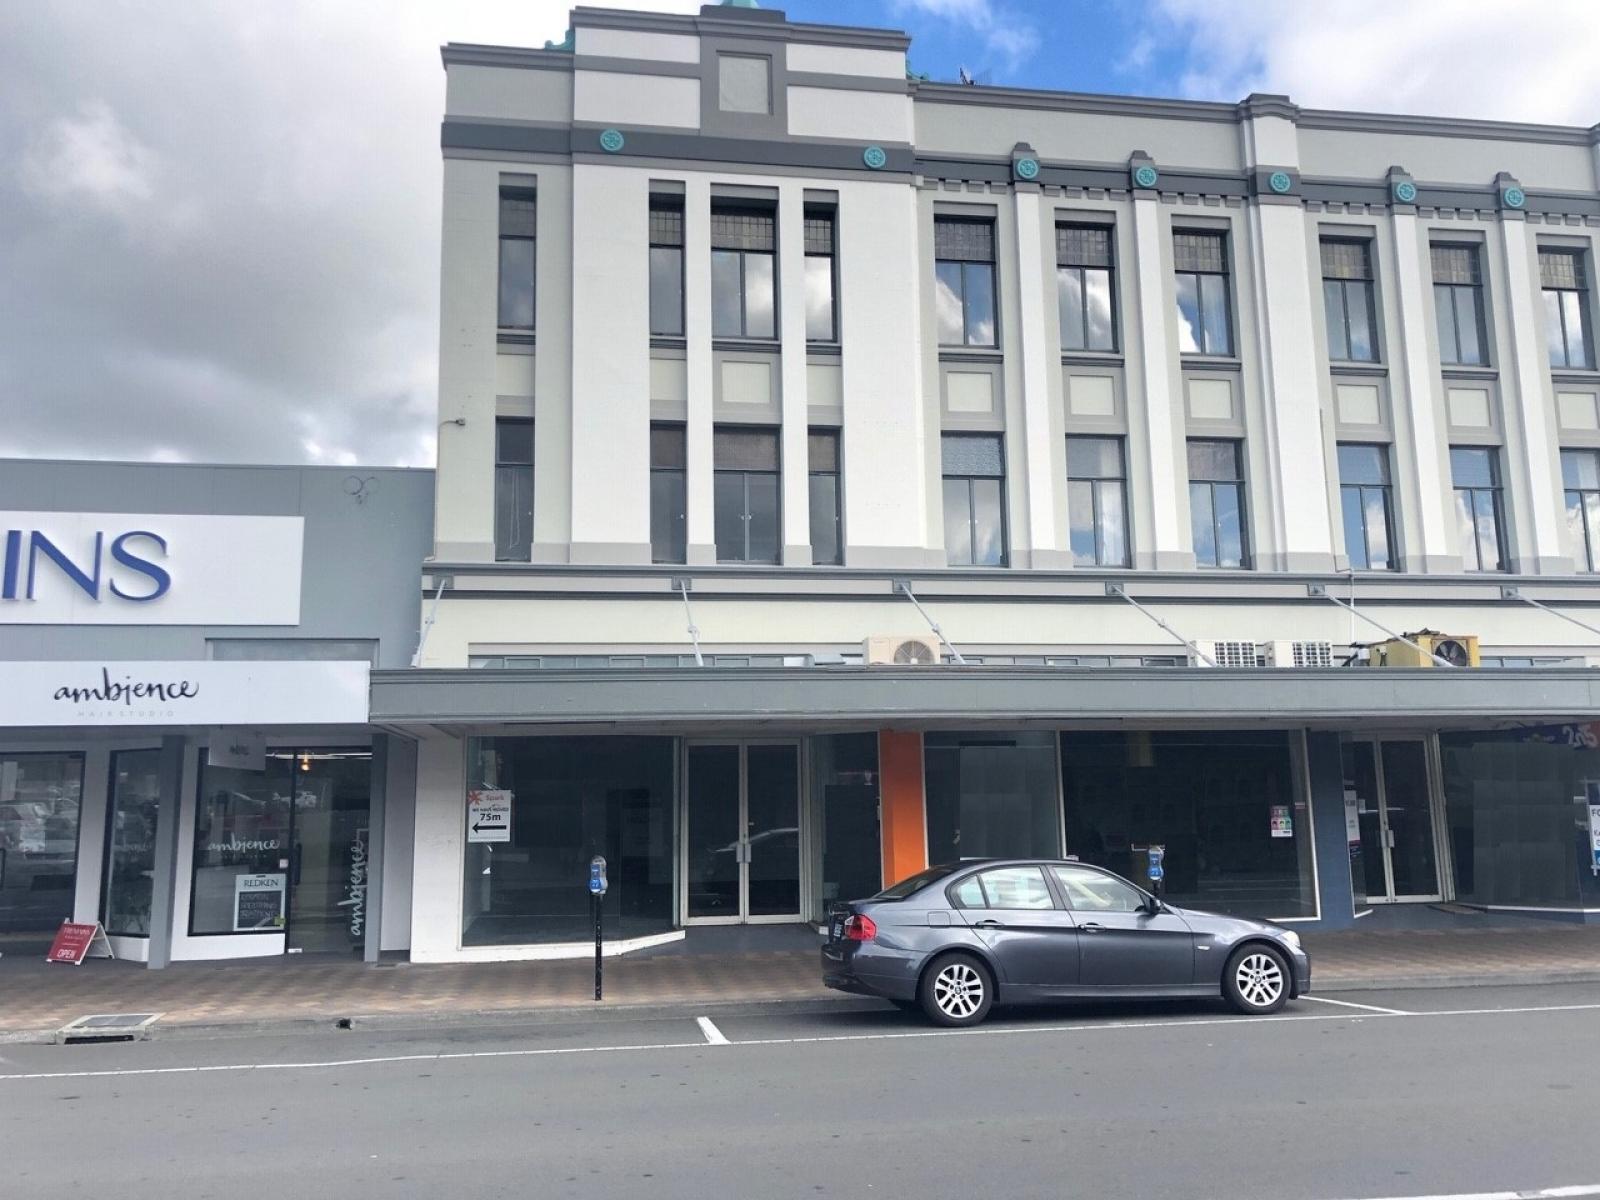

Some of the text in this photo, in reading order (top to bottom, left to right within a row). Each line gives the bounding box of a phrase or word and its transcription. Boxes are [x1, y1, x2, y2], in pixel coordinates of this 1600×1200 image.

[2, 529, 171, 601] INS
[54, 667, 199, 706] ambience
[480, 813, 501, 821] 75m
[208, 832, 281, 853] ambience
[244, 879, 279, 887] REDKEN
